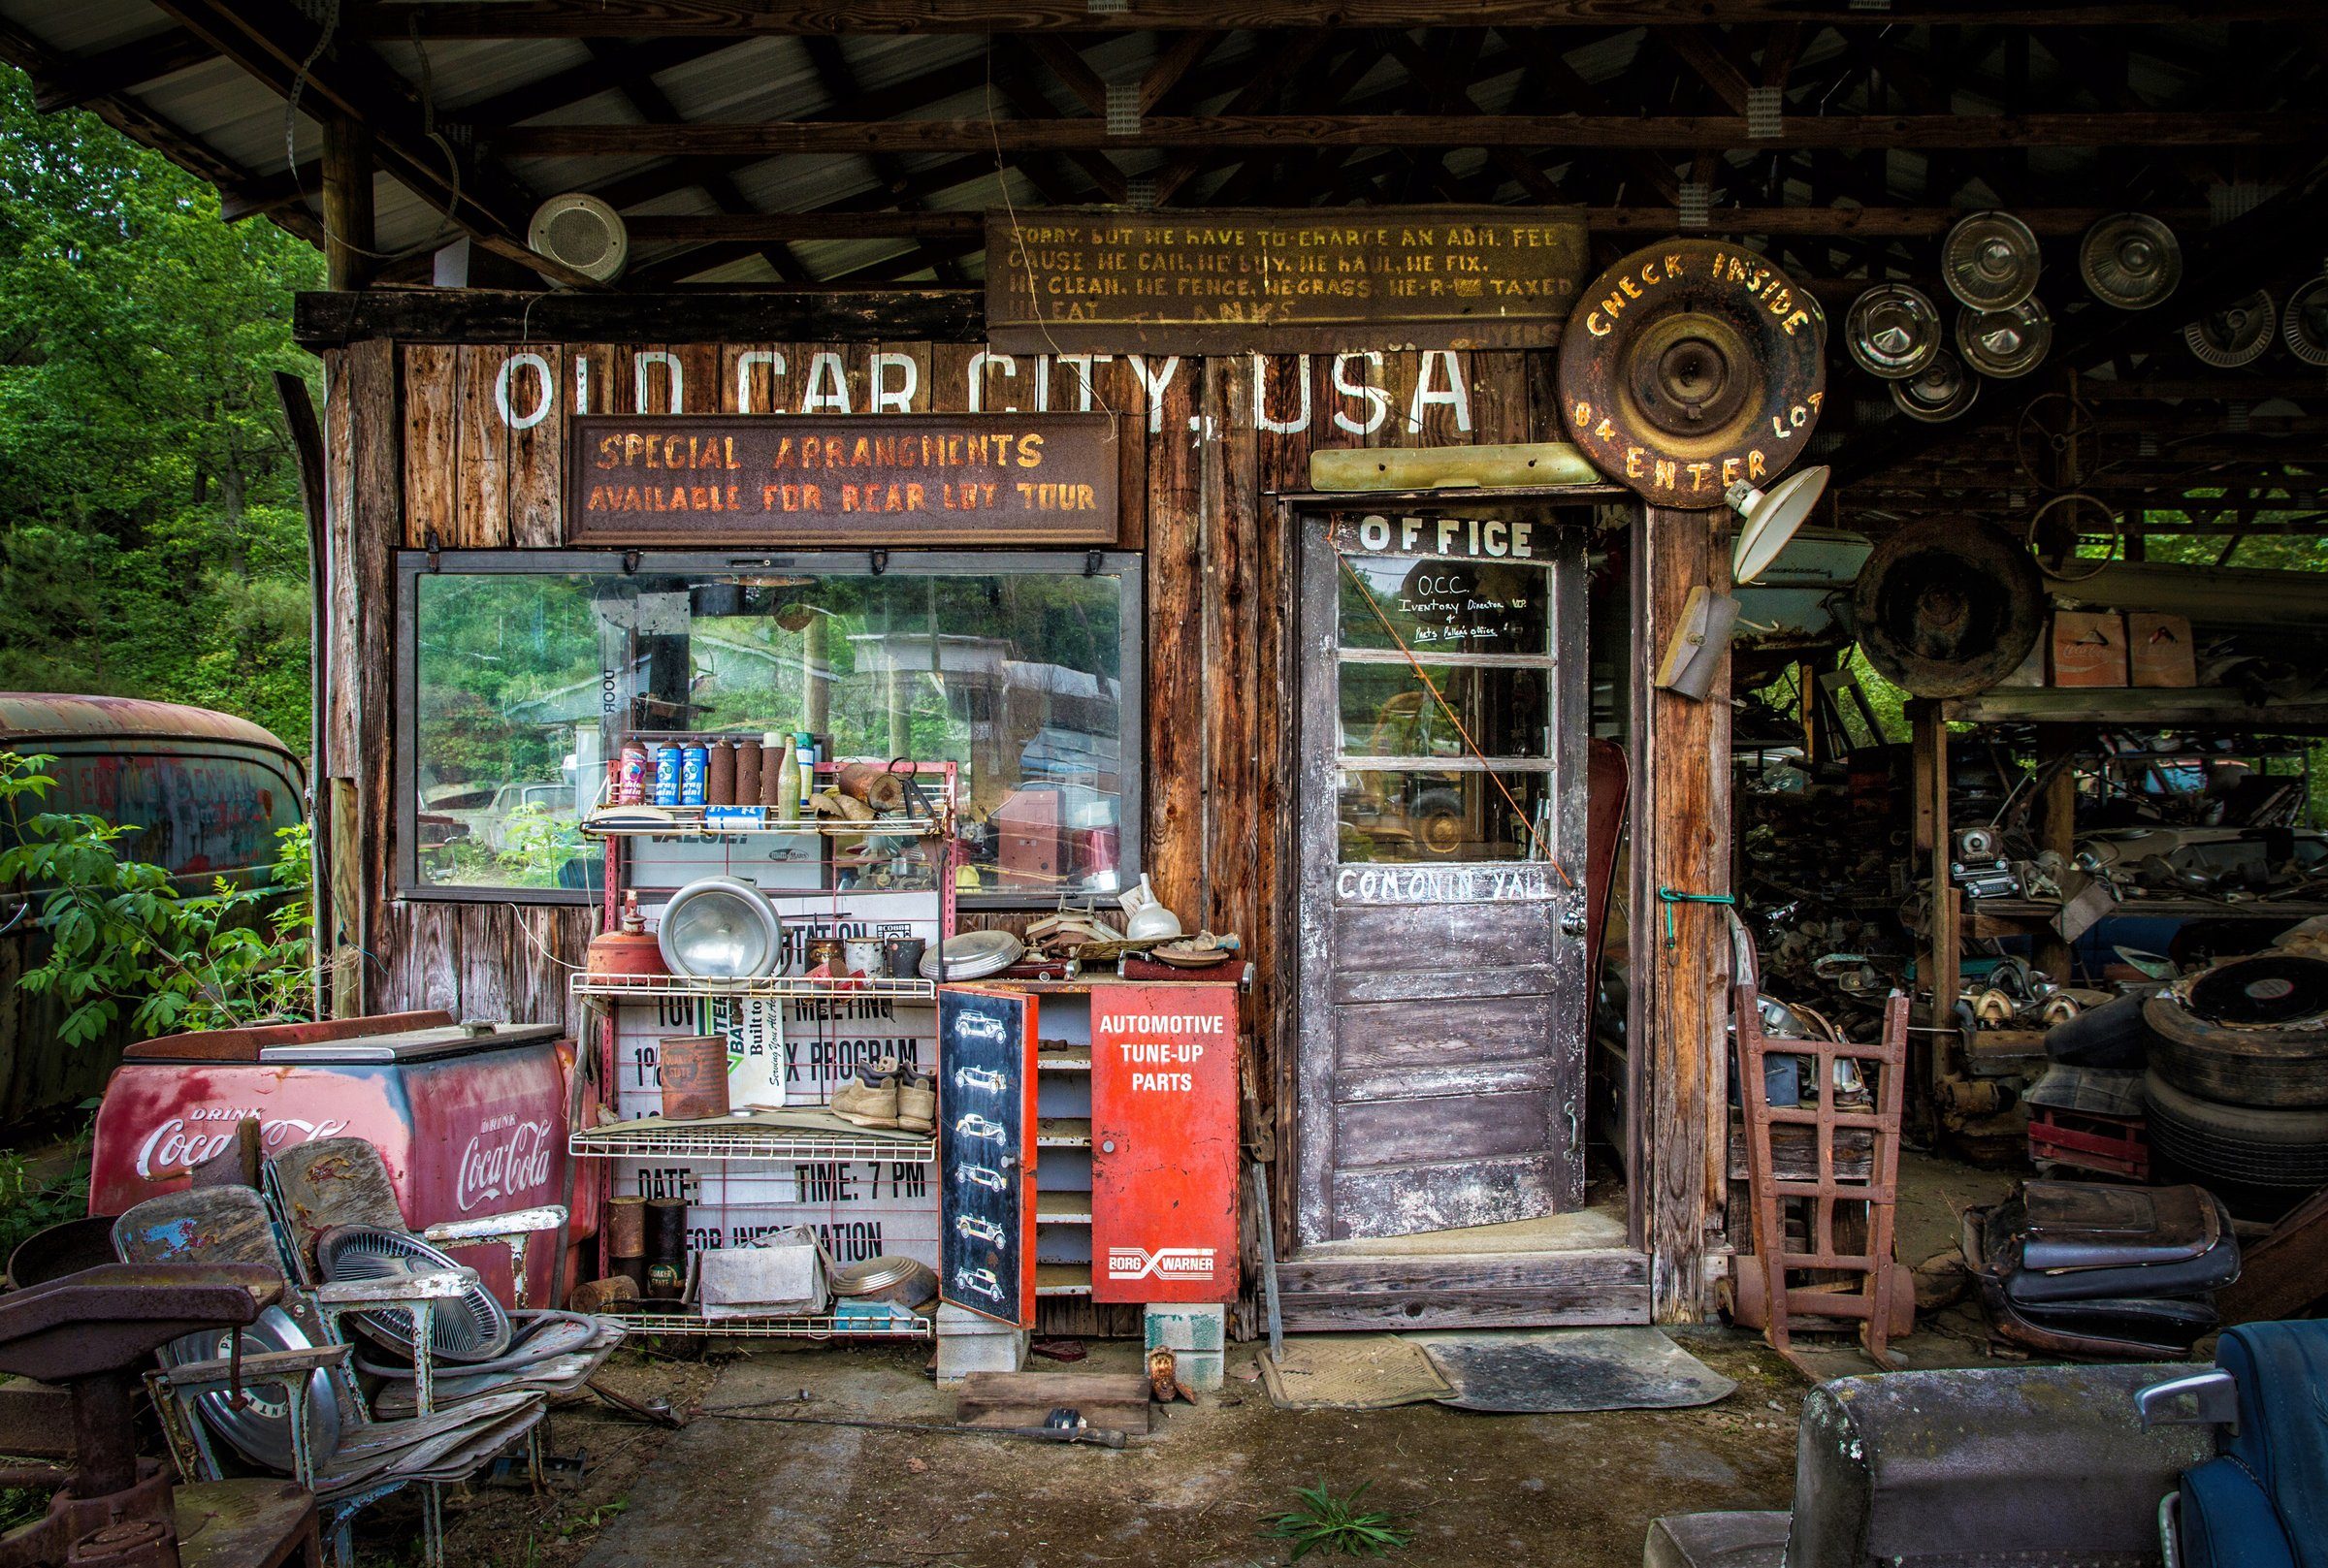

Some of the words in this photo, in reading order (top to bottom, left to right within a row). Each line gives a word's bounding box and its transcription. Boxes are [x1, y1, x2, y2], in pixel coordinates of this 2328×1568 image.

[1402, 228, 1435, 246] AN
[1446, 228, 1502, 247] ADM.
[1008, 249, 1083, 272] CAUSE
[1446, 254, 1489, 272] FIX.
[1137, 277, 1169, 296] WE
[1490, 278, 1573, 297] TAXED
[1586, 254, 1684, 336] CHECK
[1712, 252, 1810, 336] INSIDE
[1051, 301, 1100, 320] EAT
[737, 351, 916, 415] CAR
[1254, 350, 1472, 435] USA
[596, 432, 741, 470] SPECIAL
[1574, 401, 1616, 442] B4
[1626, 446, 1767, 492] ENTER
[1772, 391, 1824, 439] LOT
[586, 483, 742, 512] AVAILABLE
[762, 483, 822, 513] FOR
[842, 483, 926, 513] REAR
[944, 482, 996, 513] LOT
[1017, 481, 1098, 512] TOUR
[1360, 514, 1532, 558] OFFICE
[603, 670, 616, 713] DOOR
[752, 1001, 762, 1015] to
[1099, 1014, 1224, 1035] AUTOMOTIVE
[750, 1017, 763, 1056] Built
[1120, 1043, 1204, 1064] TUNE-UP
[1132, 1072, 1192, 1092] PARTS
[190, 1107, 267, 1121] DRINK
[481, 1113, 517, 1136] DRINK
[457, 1118, 553, 1211] Coca-Cola
[794, 1162, 858, 1203] TIME:
[868, 1161, 882, 1200] 7
[891, 1161, 927, 1199] PM
[1109, 1257, 1142, 1270] BORG
[1162, 1257, 1213, 1271] WARNER
